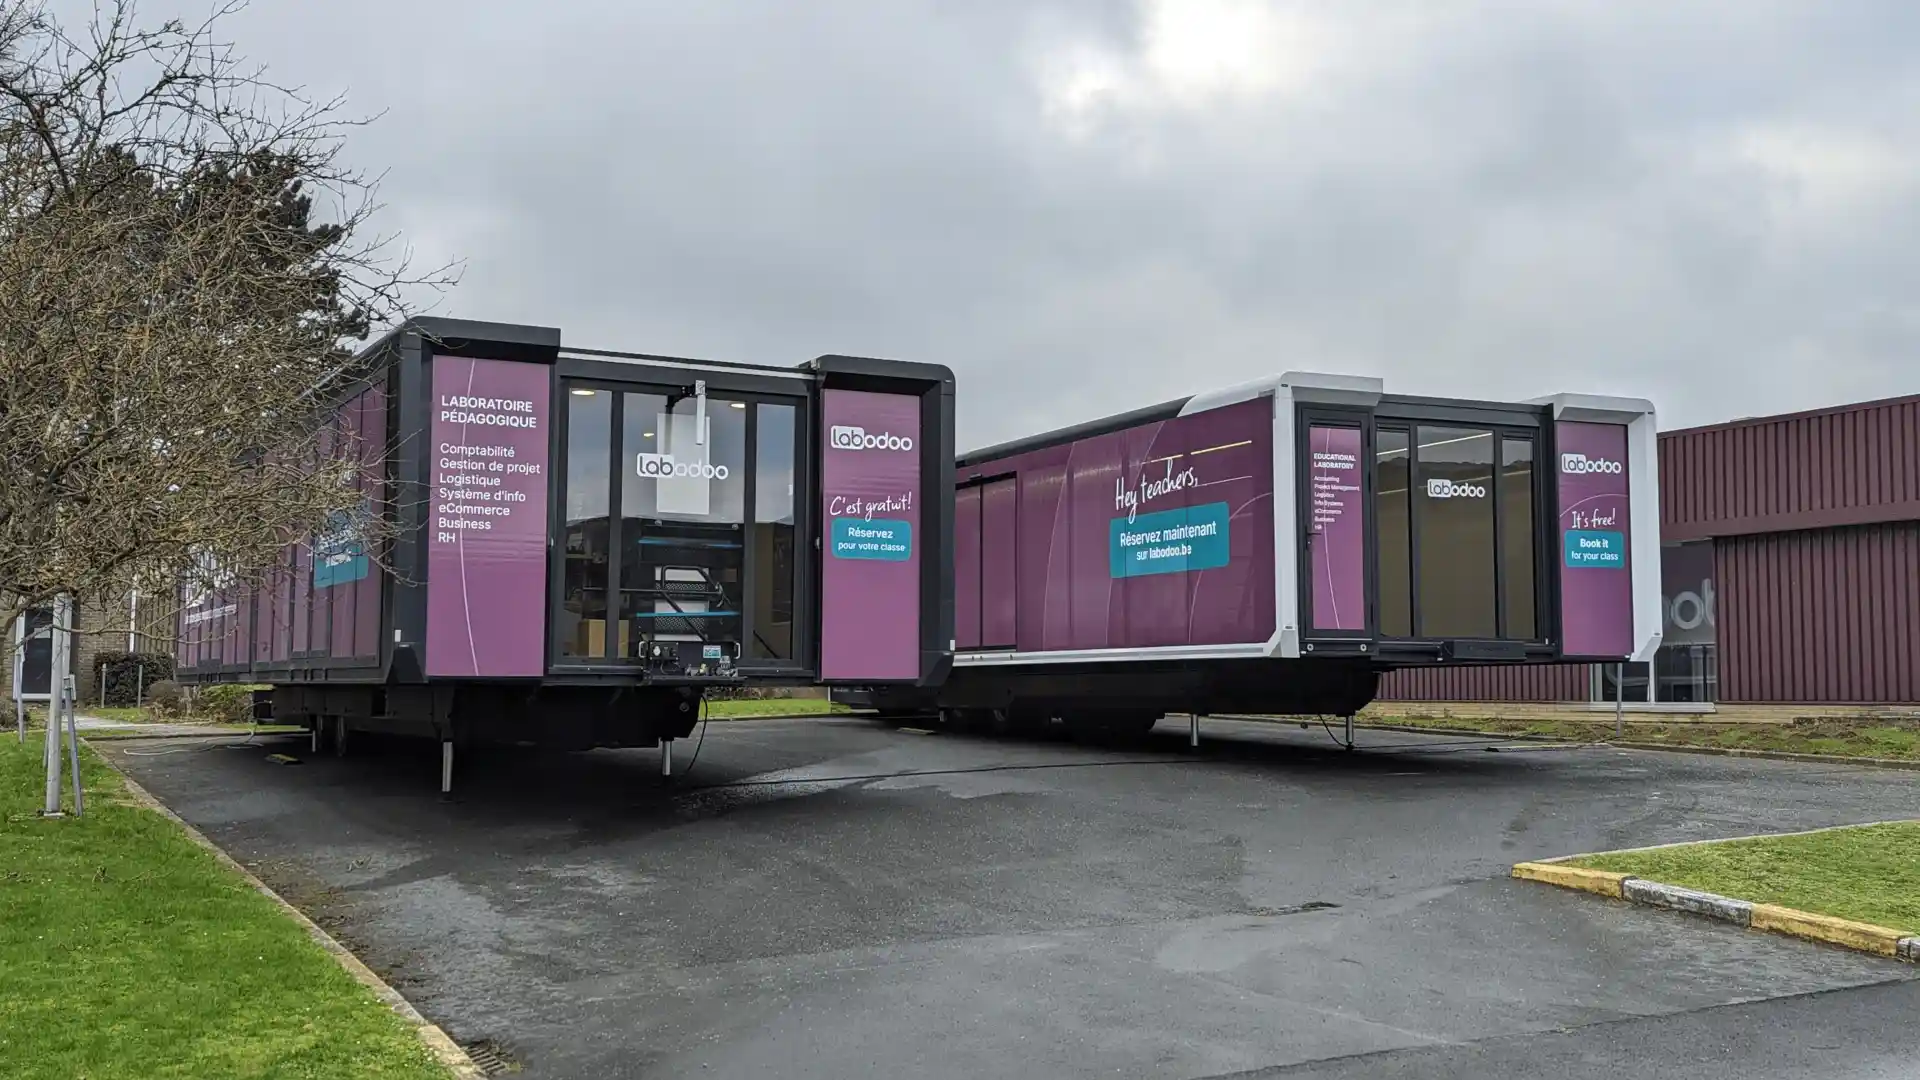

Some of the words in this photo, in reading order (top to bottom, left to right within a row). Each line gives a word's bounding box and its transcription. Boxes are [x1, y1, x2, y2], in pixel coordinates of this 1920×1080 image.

[441, 395, 533, 413] LABORATOIRE
[441, 409, 537, 428] PÉDAGOGIQUE
[830, 425, 913, 451] labodoo
[440, 443, 515, 458] Comptabilité
[1313, 453, 1357, 462] EDUCATIONAL
[440, 458, 486, 471] Gestion
[488, 460, 504, 472] de
[507, 462, 541, 476] projet
[637, 453, 729, 480] labodoo
[1313, 461, 1354, 470] LABORATORY
[1561, 453, 1622, 474] labodoo
[439, 473, 501, 487] Logistique
[1427, 478, 1486, 498] labodoo
[439, 488, 490, 500] Système
[493, 490, 526, 502] d'info
[1115, 477, 1138, 524] Hey
[1140, 458, 1198, 503] teachers,
[438, 503, 510, 516] eCommerce
[829, 495, 863, 516] C'est
[864, 491, 912, 522] gratuit!
[438, 517, 492, 530] Business
[1571, 510, 1589, 529] It's
[1591, 507, 1616, 528] free!
[438, 532, 456, 543] RH
[848, 527, 894, 539] Réservez
[1120, 529, 1161, 548] Réservez
[1163, 520, 1217, 542] maintenant
[838, 542, 856, 551] pour
[858, 542, 879, 551] votre
[880, 543, 906, 552] classe
[1580, 538, 1601, 548] Book
[1602, 538, 1609, 549] it
[1136, 549, 1149, 561] sur
[1149, 543, 1192, 559] labodoo.be
[1571, 550, 1581, 560] for
[1583, 552, 1599, 562] your
[1600, 552, 1619, 561] class
